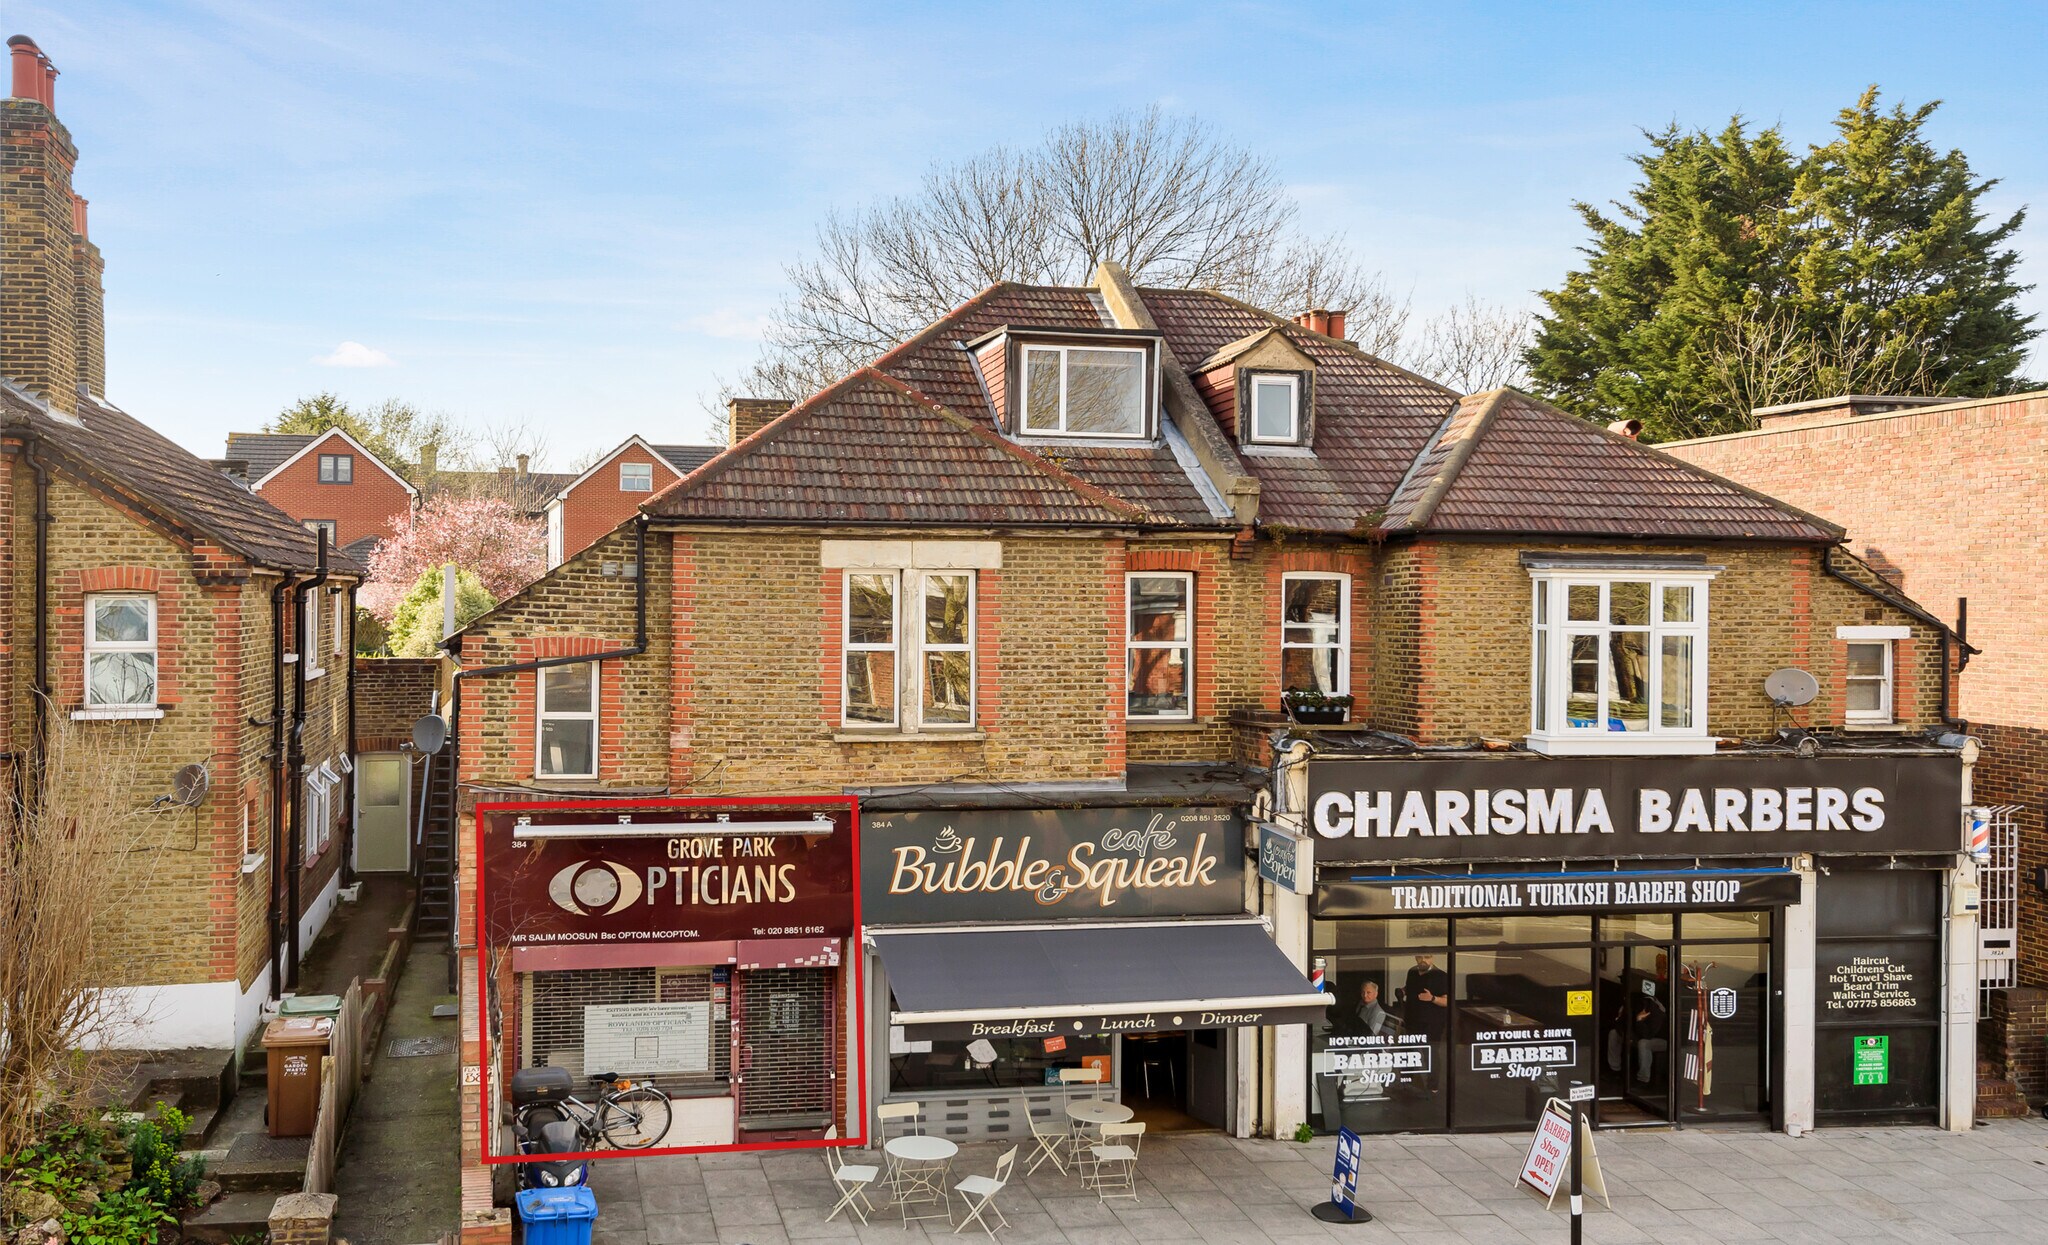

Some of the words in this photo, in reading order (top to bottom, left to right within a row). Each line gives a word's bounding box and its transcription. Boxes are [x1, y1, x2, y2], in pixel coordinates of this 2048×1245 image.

[1313, 788, 1615, 838] CHARISMA
[1637, 786, 1886, 833] BARBERS
[1101, 813, 1177, 857] café
[667, 838, 723, 859] GROVE
[733, 837, 776, 857] PARK
[888, 836, 1050, 894] Bubble
[1035, 866, 1067, 905] &
[1064, 833, 1217, 907] Squeak
[1391, 884, 1522, 909] TRADITIONAL
[1527, 882, 1609, 907] TURKISH
[1614, 881, 1687, 905] BARBER
[1691, 880, 1740, 903] SHOP
[528, 933, 556, 942] SALIM
[557, 932, 598, 941] MOOSUN
[618, 931, 650, 940] OPTOM
[752, 927, 766, 935] Tel:
[767, 927, 783, 935] 020
[784, 927, 803, 935] 8851
[805, 926, 825, 934] 6162
[1837, 965, 1885, 974] Childrens
[1887, 965, 1905, 973] Cut
[1853, 956, 1889, 965] Haircut
[1829, 975, 1847, 983] Hot
[1850, 974, 1880, 982] Towel
[1883, 973, 1913, 981] Shave
[1843, 982, 1873, 991] Beard
[1875, 981, 1899, 990] Trim
[1826, 1000, 1844, 1009] Tel.
[1846, 1000, 1877, 1009] 07775
[1880, 998, 1917, 1007] 856863
[1873, 990, 1909, 998] Service
[972, 1020, 1056, 1037] Breakfast
[1100, 1014, 1155, 1030] Lunch
[1200, 1012, 1262, 1025] Dinner
[1476, 1031, 1497, 1040] HOT
[1499, 1030, 1531, 1040] TOWEL
[1534, 1029, 1540, 1038] &
[1543, 1028, 1572, 1038] SHAVE
[1329, 1037, 1350, 1046] HOT
[1353, 1036, 1385, 1045] TOWEL
[1388, 1035, 1395, 1044] &
[1398, 1034, 1427, 1044] SHAVE
[1334, 1052, 1422, 1070] BARBER
[1480, 1045, 1567, 1064] BARBER
[1360, 1068, 1396, 1087] Shop
[1506, 1062, 1542, 1081] Shop
[1543, 1119, 1571, 1144] BARBER
[1540, 1137, 1561, 1160] Shop
[1534, 1154, 1556, 1176] OPEN
